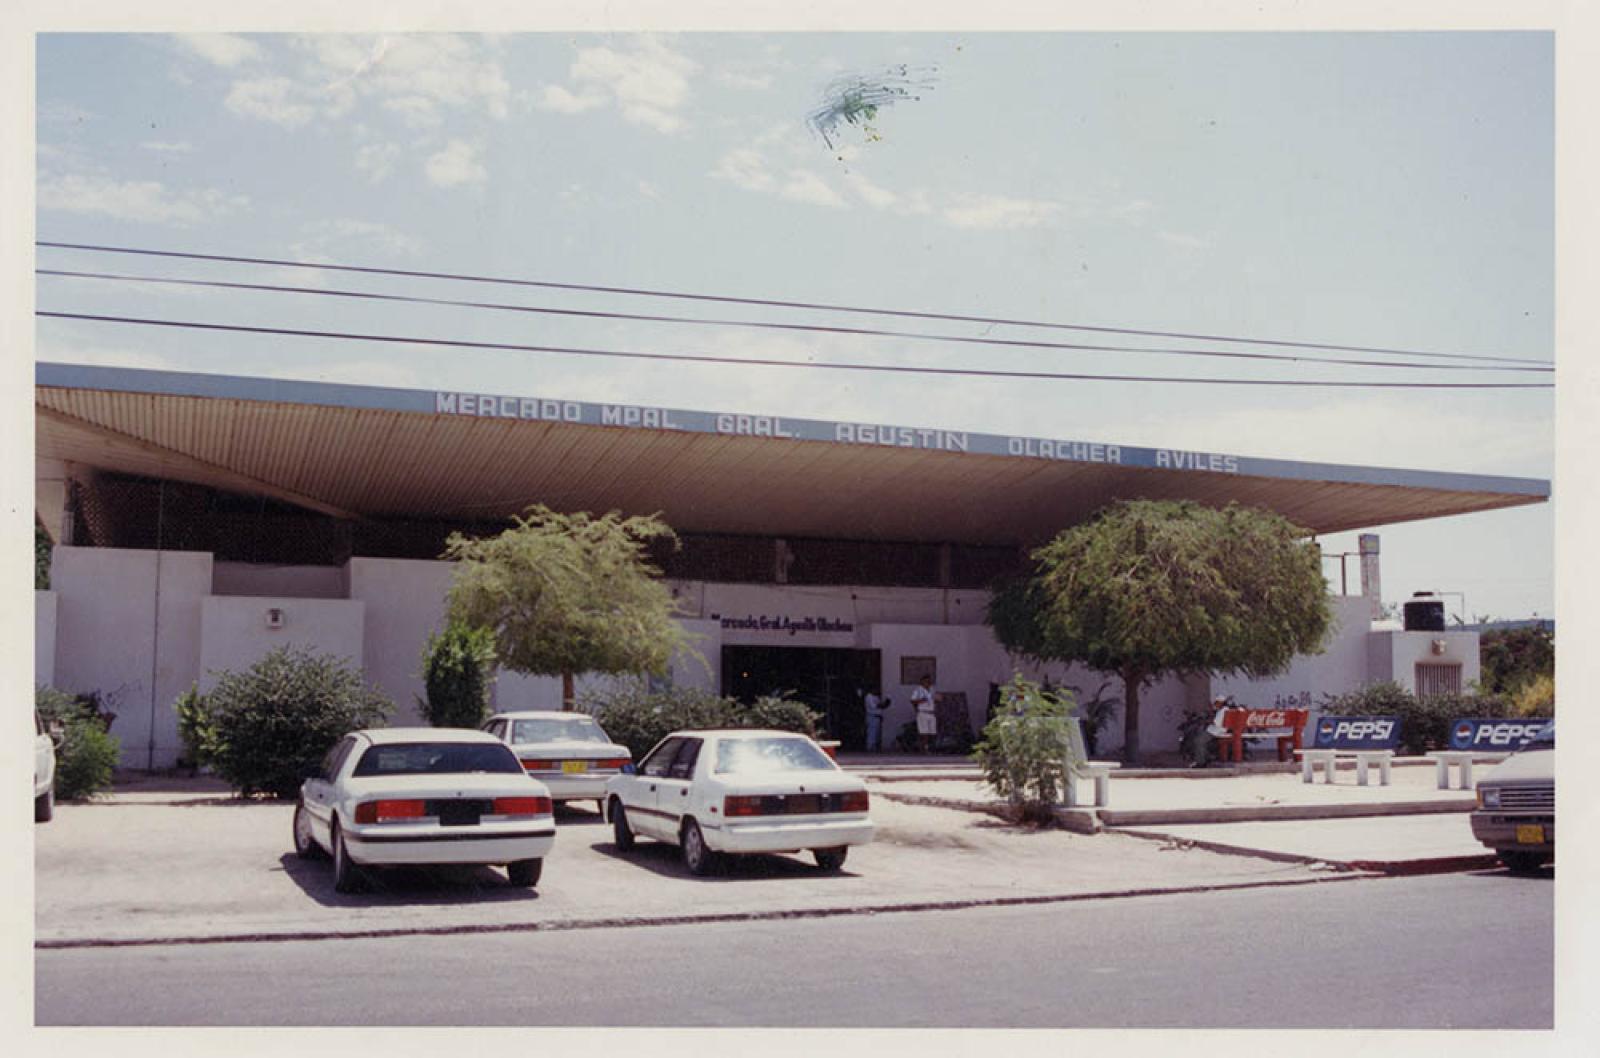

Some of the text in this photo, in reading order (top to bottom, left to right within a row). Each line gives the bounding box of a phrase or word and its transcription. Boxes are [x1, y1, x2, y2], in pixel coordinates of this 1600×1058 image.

[436, 392, 581, 422] MERCADO
[717, 415, 801, 438] GRAL.
[835, 423, 968, 451] AGUSTIN
[1008, 437, 1121, 463] OLACHEA
[1156, 449, 1239, 473] AVILES
[1334, 720, 1395, 740] PEPSI
[1474, 723, 1544, 745] PEPS
